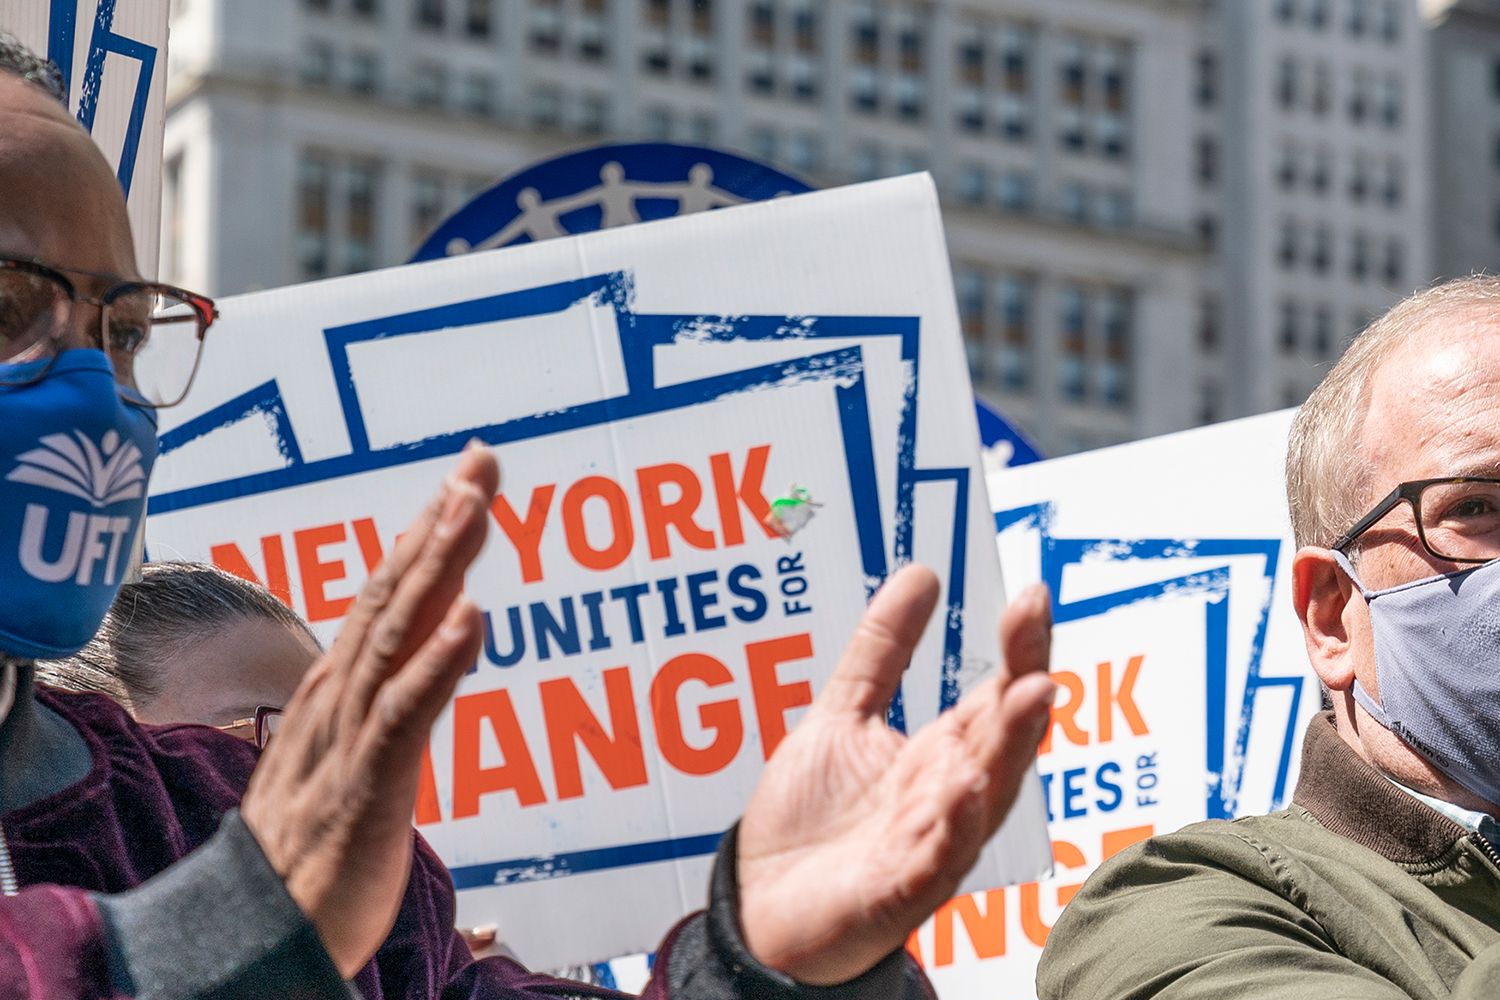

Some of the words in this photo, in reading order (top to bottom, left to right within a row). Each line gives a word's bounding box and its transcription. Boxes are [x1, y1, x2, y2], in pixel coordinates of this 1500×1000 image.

[18, 503, 131, 586] UFT
[210, 516, 408, 624] NE
[489, 445, 780, 584] YORK
[464, 564, 768, 676] UNITIES
[777, 552, 813, 617] FOR
[414, 633, 815, 826] ANGE
[1040, 655, 1150, 754] RK
[1136, 751, 1159, 809] FOR
